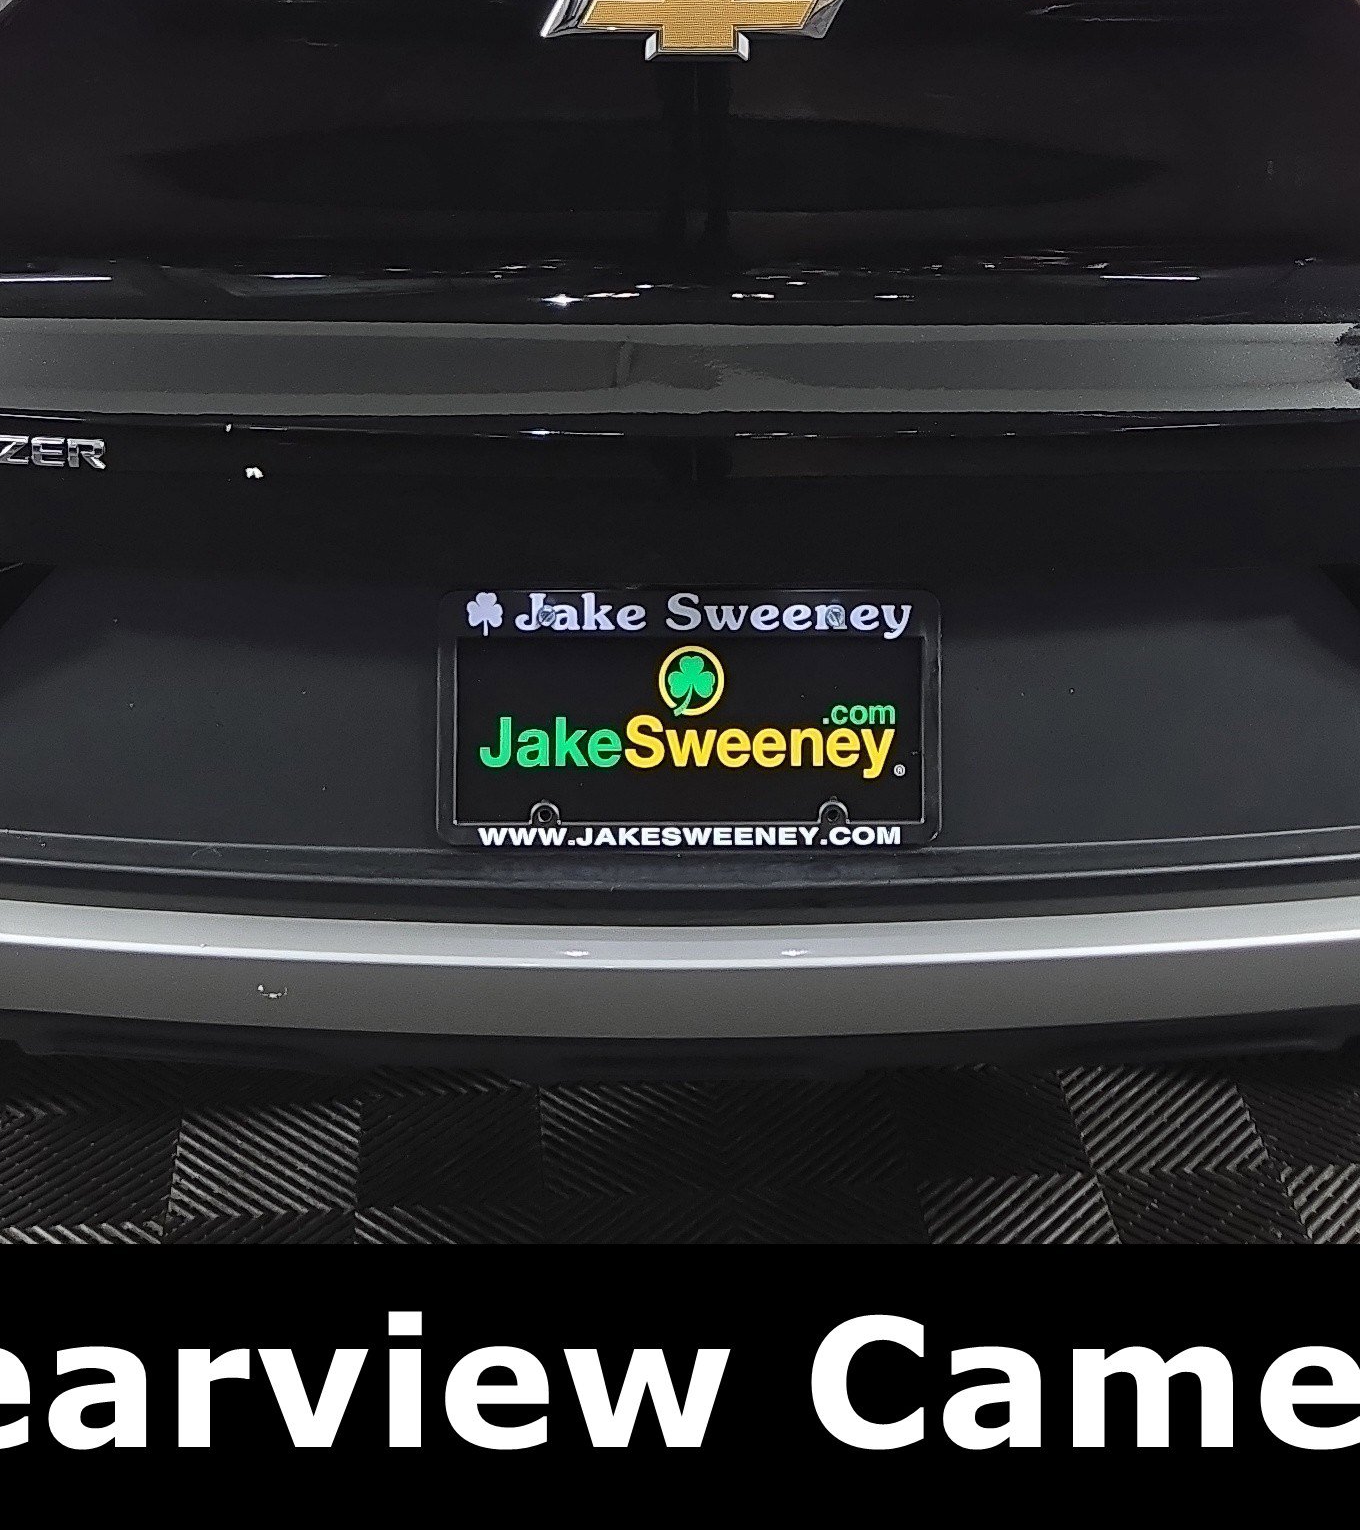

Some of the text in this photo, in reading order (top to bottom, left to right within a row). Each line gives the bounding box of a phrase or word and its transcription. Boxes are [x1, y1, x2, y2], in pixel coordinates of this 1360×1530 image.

[514, 592, 913, 640] Jake Sweeney
[822, 703, 896, 726] .com
[477, 826, 902, 847] WWW.JAKESWEENEY.COM
